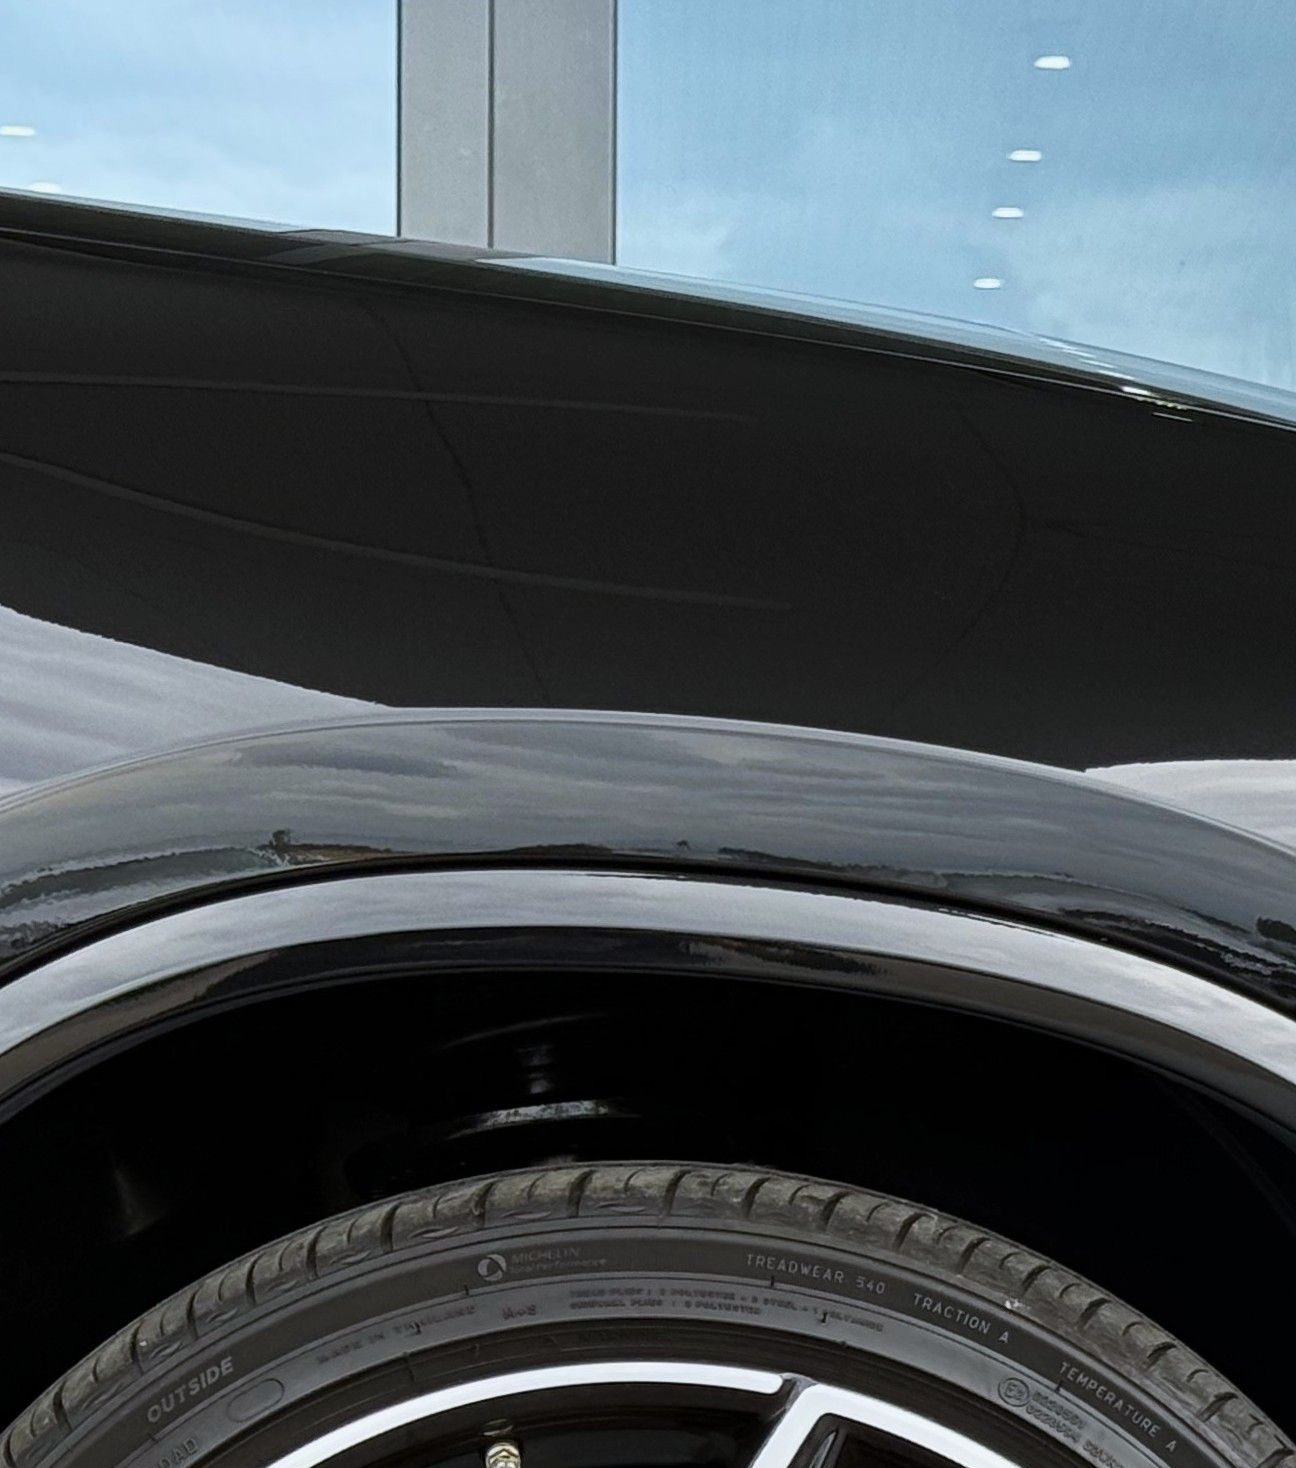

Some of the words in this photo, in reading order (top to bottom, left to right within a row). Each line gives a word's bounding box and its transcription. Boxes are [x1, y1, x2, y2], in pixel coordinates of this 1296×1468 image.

[746, 1253, 845, 1285] TREADWEAR
[855, 1276, 886, 1294] 540
[912, 1292, 992, 1335] TRACTION
[998, 1330, 1010, 1344] A
[146, 1357, 236, 1424] OUTSIDE
[1058, 1361, 1162, 1439] TEMPERATURE
[1164, 1440, 1177, 1453] A
